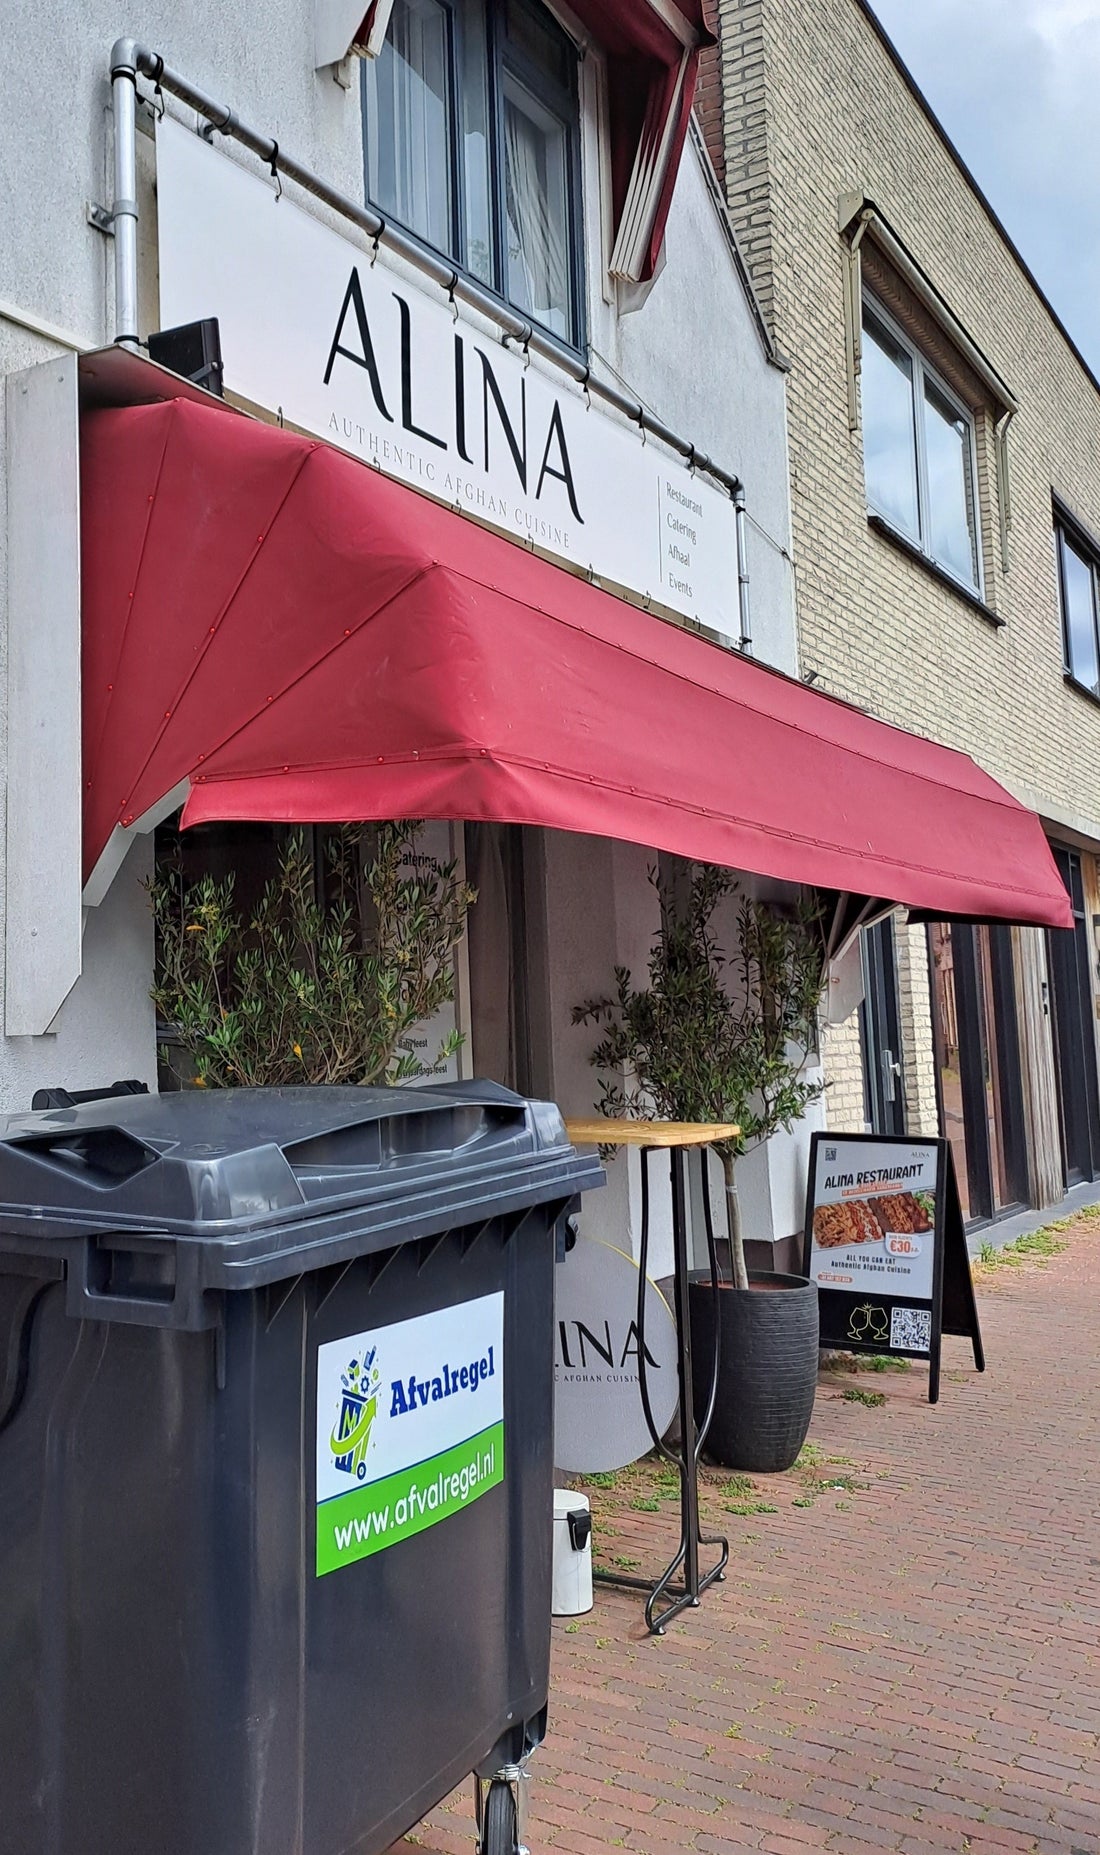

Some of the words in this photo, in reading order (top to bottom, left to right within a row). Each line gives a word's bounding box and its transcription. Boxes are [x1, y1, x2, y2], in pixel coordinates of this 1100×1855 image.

[323, 266, 584, 524] ALINA
[328, 411, 436, 481] AUTHENTIC
[444, 473, 508, 517] AFGHAN
[514, 509, 570, 549] CUISINE
[666, 482, 703, 518] Restaurant
[667, 512, 697, 546] Catering
[668, 544, 690, 567] Afhaal
[669, 572, 693, 598] Events
[824, 1173, 854, 1189] ALINA
[856, 1163, 924, 1185] RESTAURANT
[846, 1254, 856, 1262] ALL
[859, 1255, 870, 1263] YOU
[871, 1256, 883, 1264] CAN
[885, 1257, 896, 1265] EAT
[890, 1239, 911, 1254] €30
[831, 1260, 861, 1270] Authentic
[887, 1266, 911, 1274] Cuisine
[555, 1320, 661, 1369] INA
[389, 1345, 495, 1418] Afvalregel
[333, 1443, 495, 1551] www.afvalregel.nl
